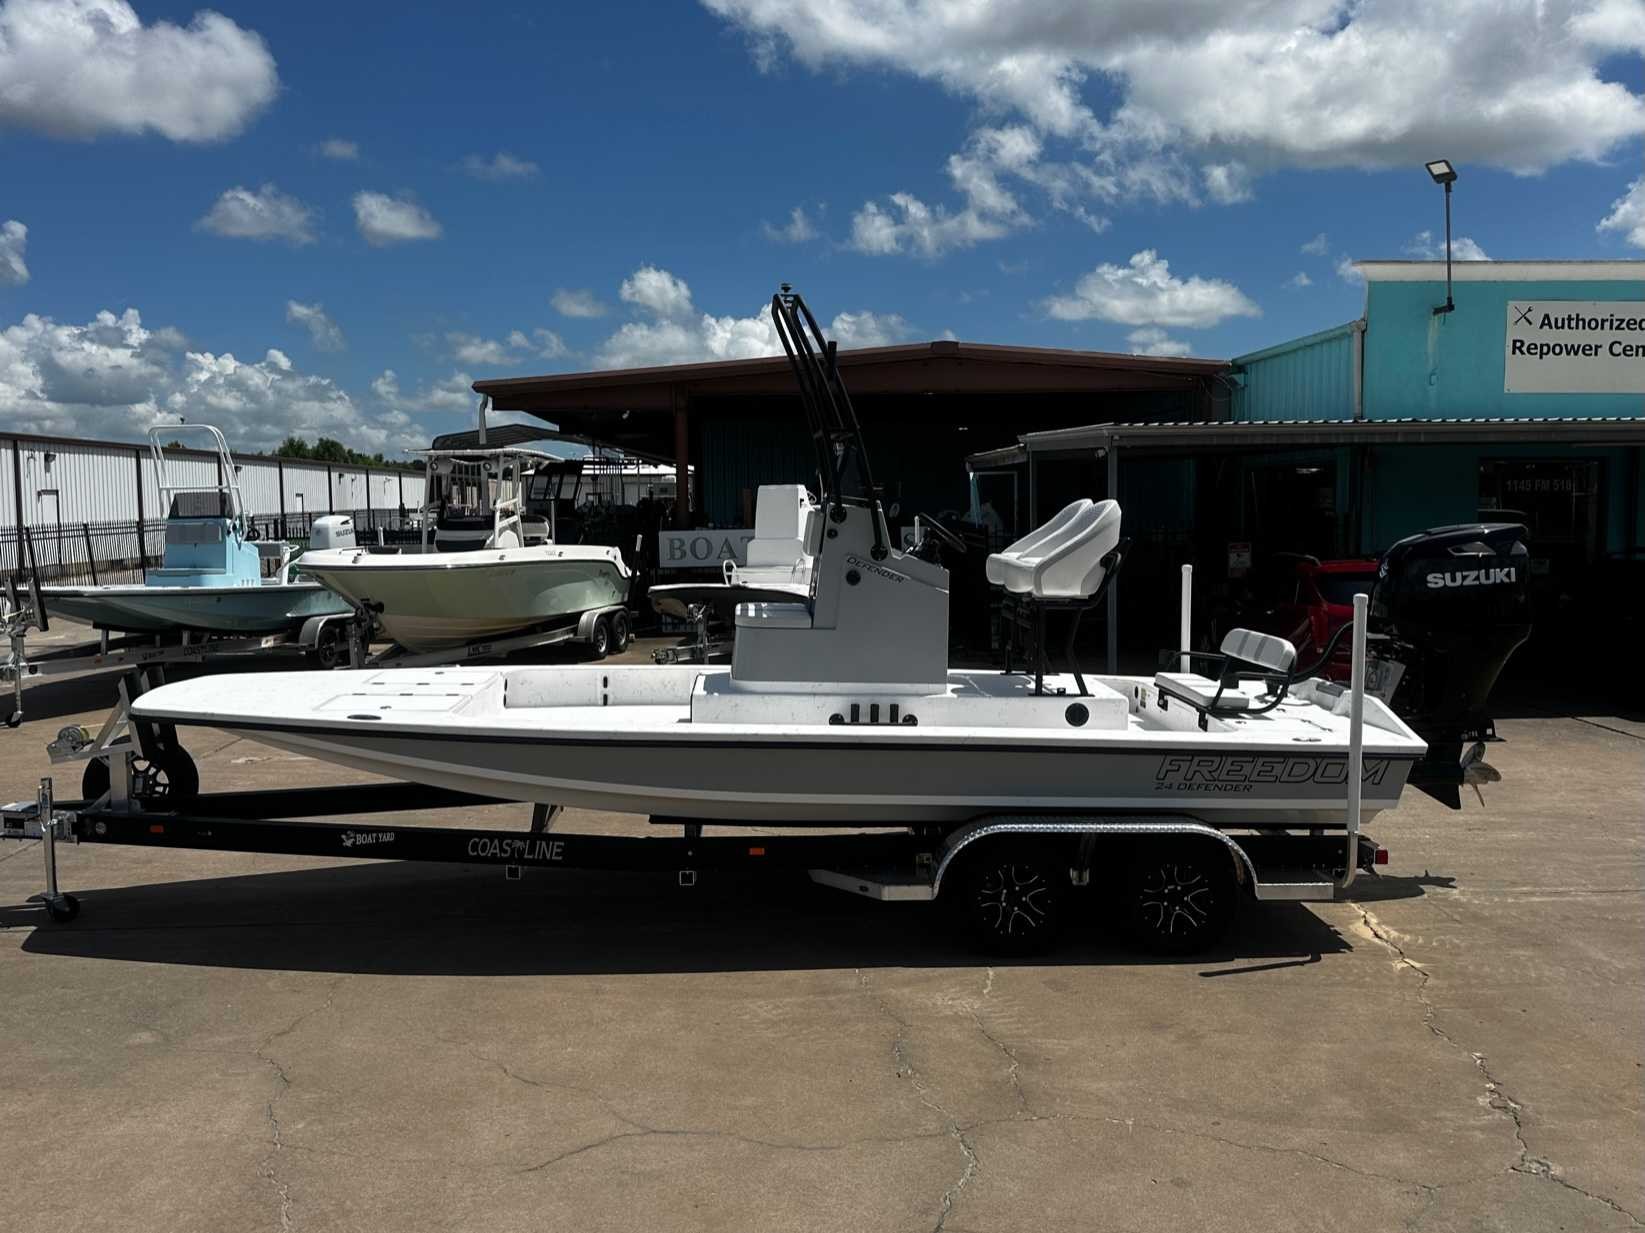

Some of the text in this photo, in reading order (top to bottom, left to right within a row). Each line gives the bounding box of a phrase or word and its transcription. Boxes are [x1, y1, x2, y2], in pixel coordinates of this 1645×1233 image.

[1511, 339, 1602, 360] Repower
[847, 556, 905, 583] DEFENDER
[1426, 567, 1516, 588] SUZUKI
[1156, 754, 1391, 785] FREEDOM
[1154, 782, 1253, 793] 24 DEFENDER
[356, 831, 395, 846] BOAT YARD
